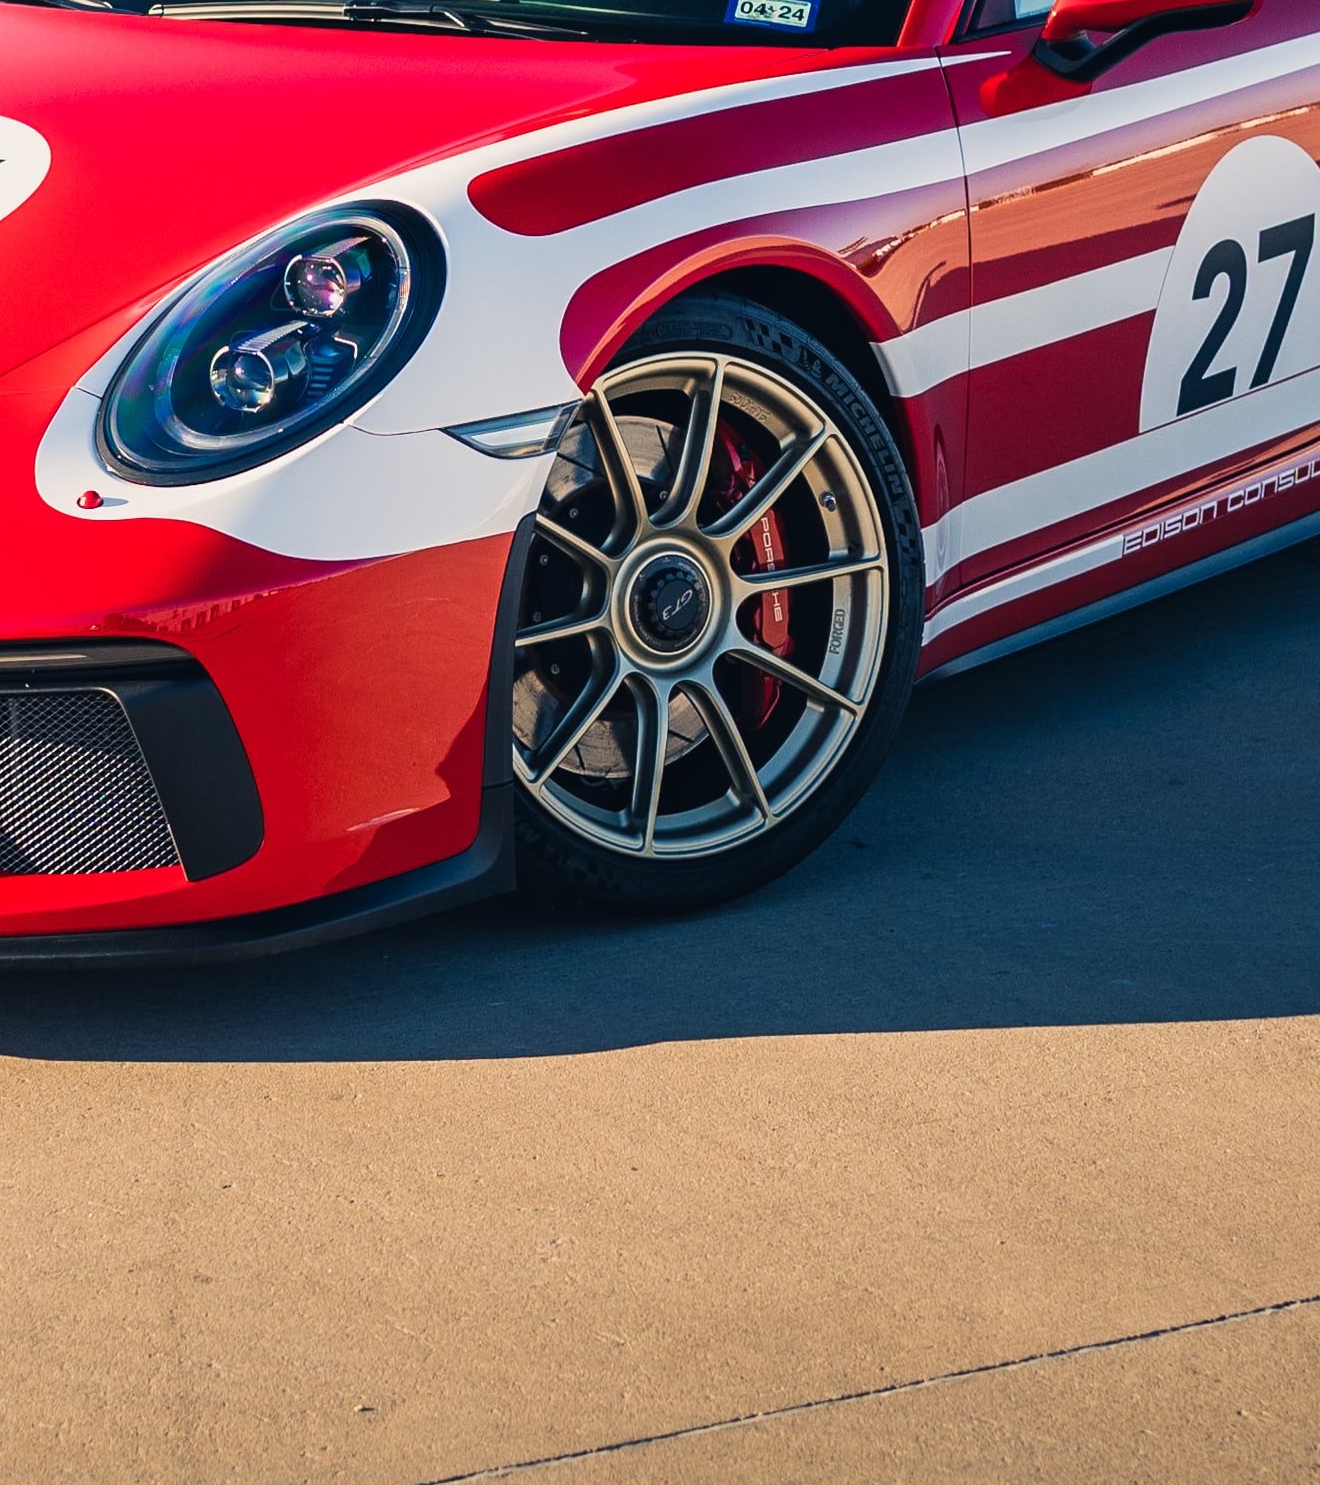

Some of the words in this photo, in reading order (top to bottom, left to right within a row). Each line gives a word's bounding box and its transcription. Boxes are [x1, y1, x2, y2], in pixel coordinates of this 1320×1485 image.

[740, 1, 767, 16] 04
[778, 5, 805, 21] 24
[1176, 212, 1315, 417] 27
[825, 372, 904, 495] MICHELIN
[1123, 500, 1217, 555] EDISON
[760, 516, 783, 622] PORSHE
[662, 589, 693, 620] GT3
[828, 608, 846, 655] FORGED
